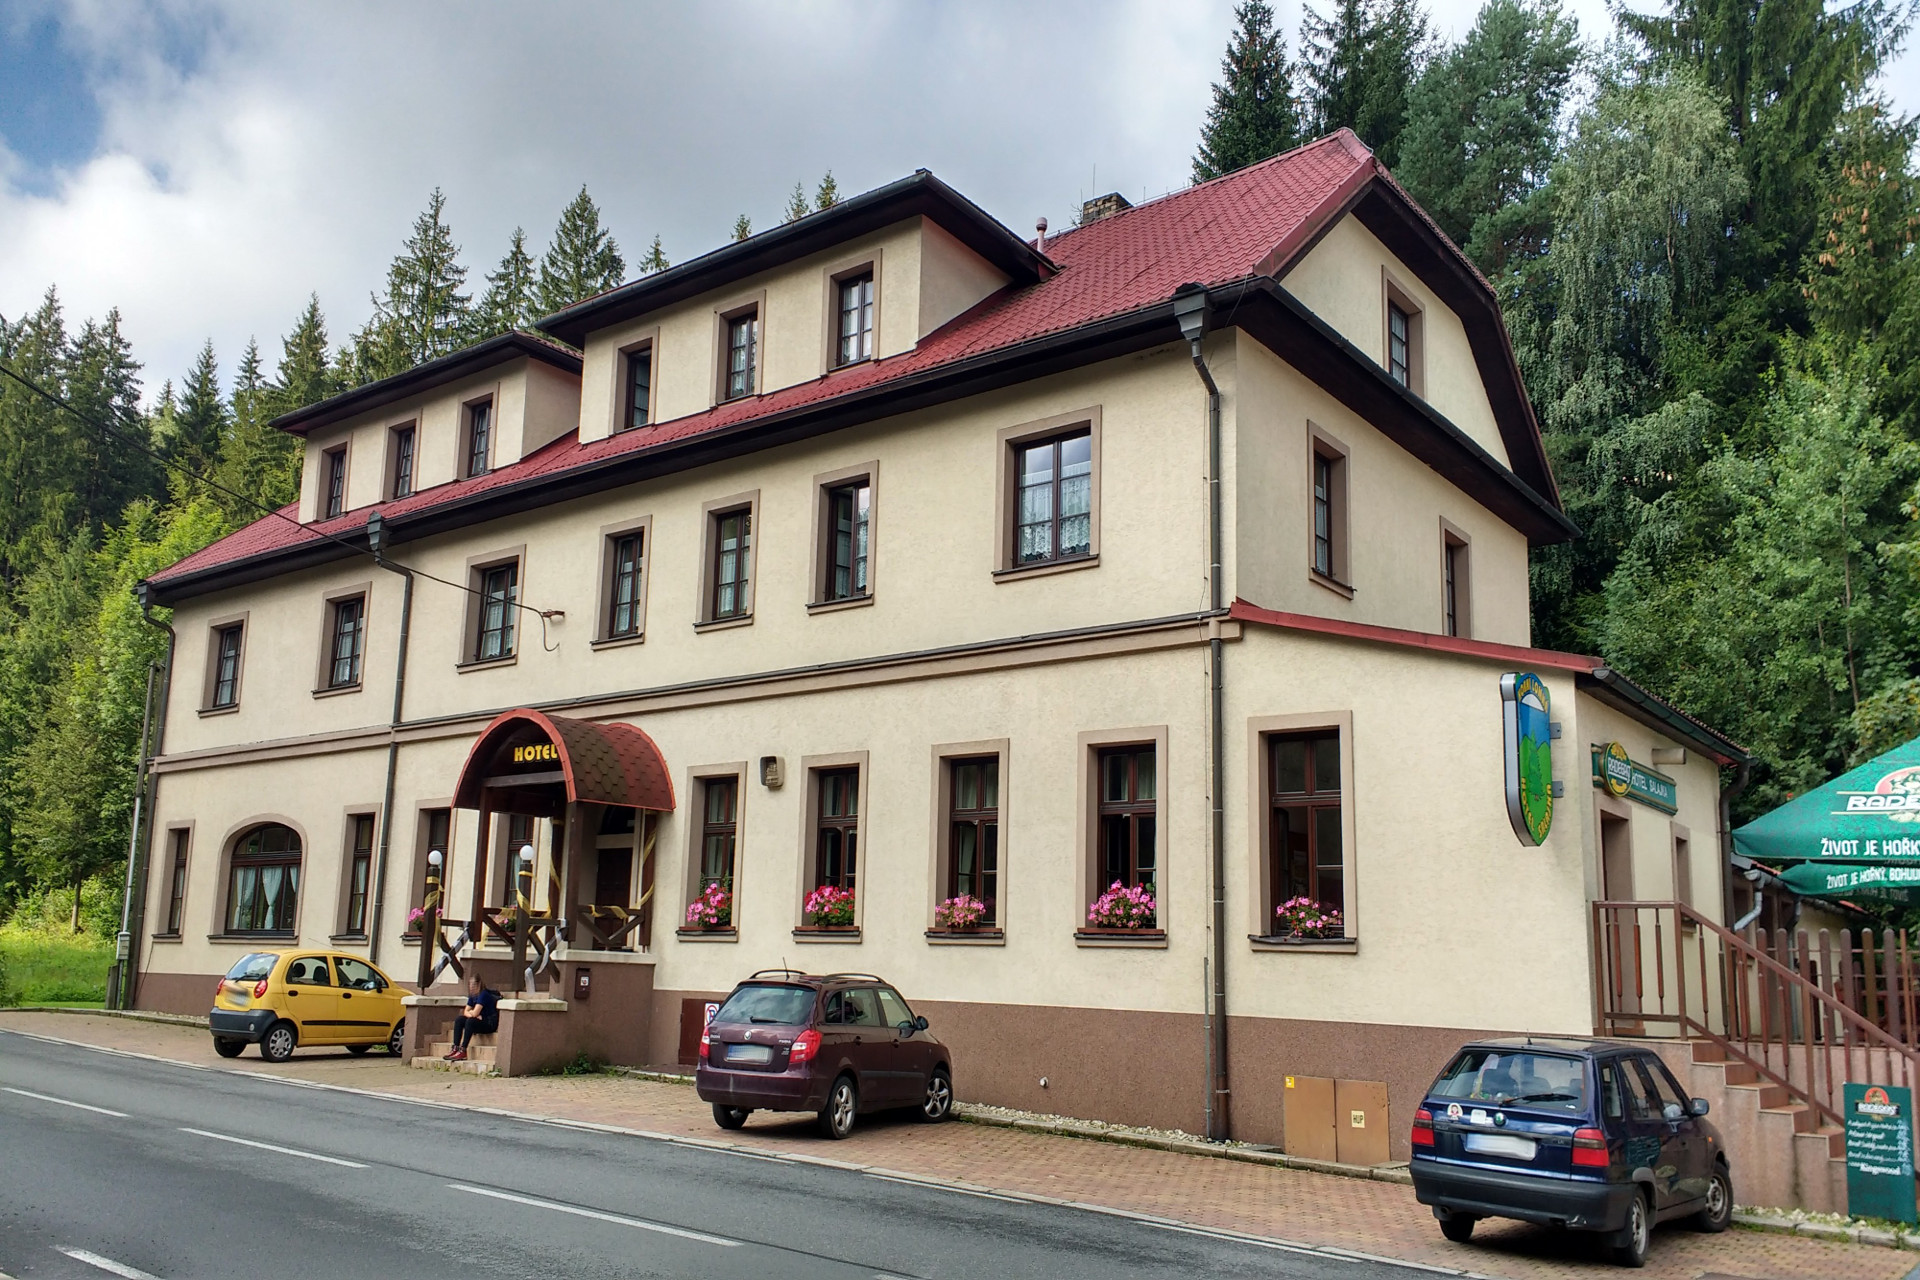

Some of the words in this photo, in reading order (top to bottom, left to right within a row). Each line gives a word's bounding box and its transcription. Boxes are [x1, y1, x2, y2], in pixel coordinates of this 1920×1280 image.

[514, 743, 558, 762] HOTEL
[1820, 837, 1859, 856] ŽIVOT
[1863, 840, 1879, 856] JE
[1850, 871, 1859, 886] JE
